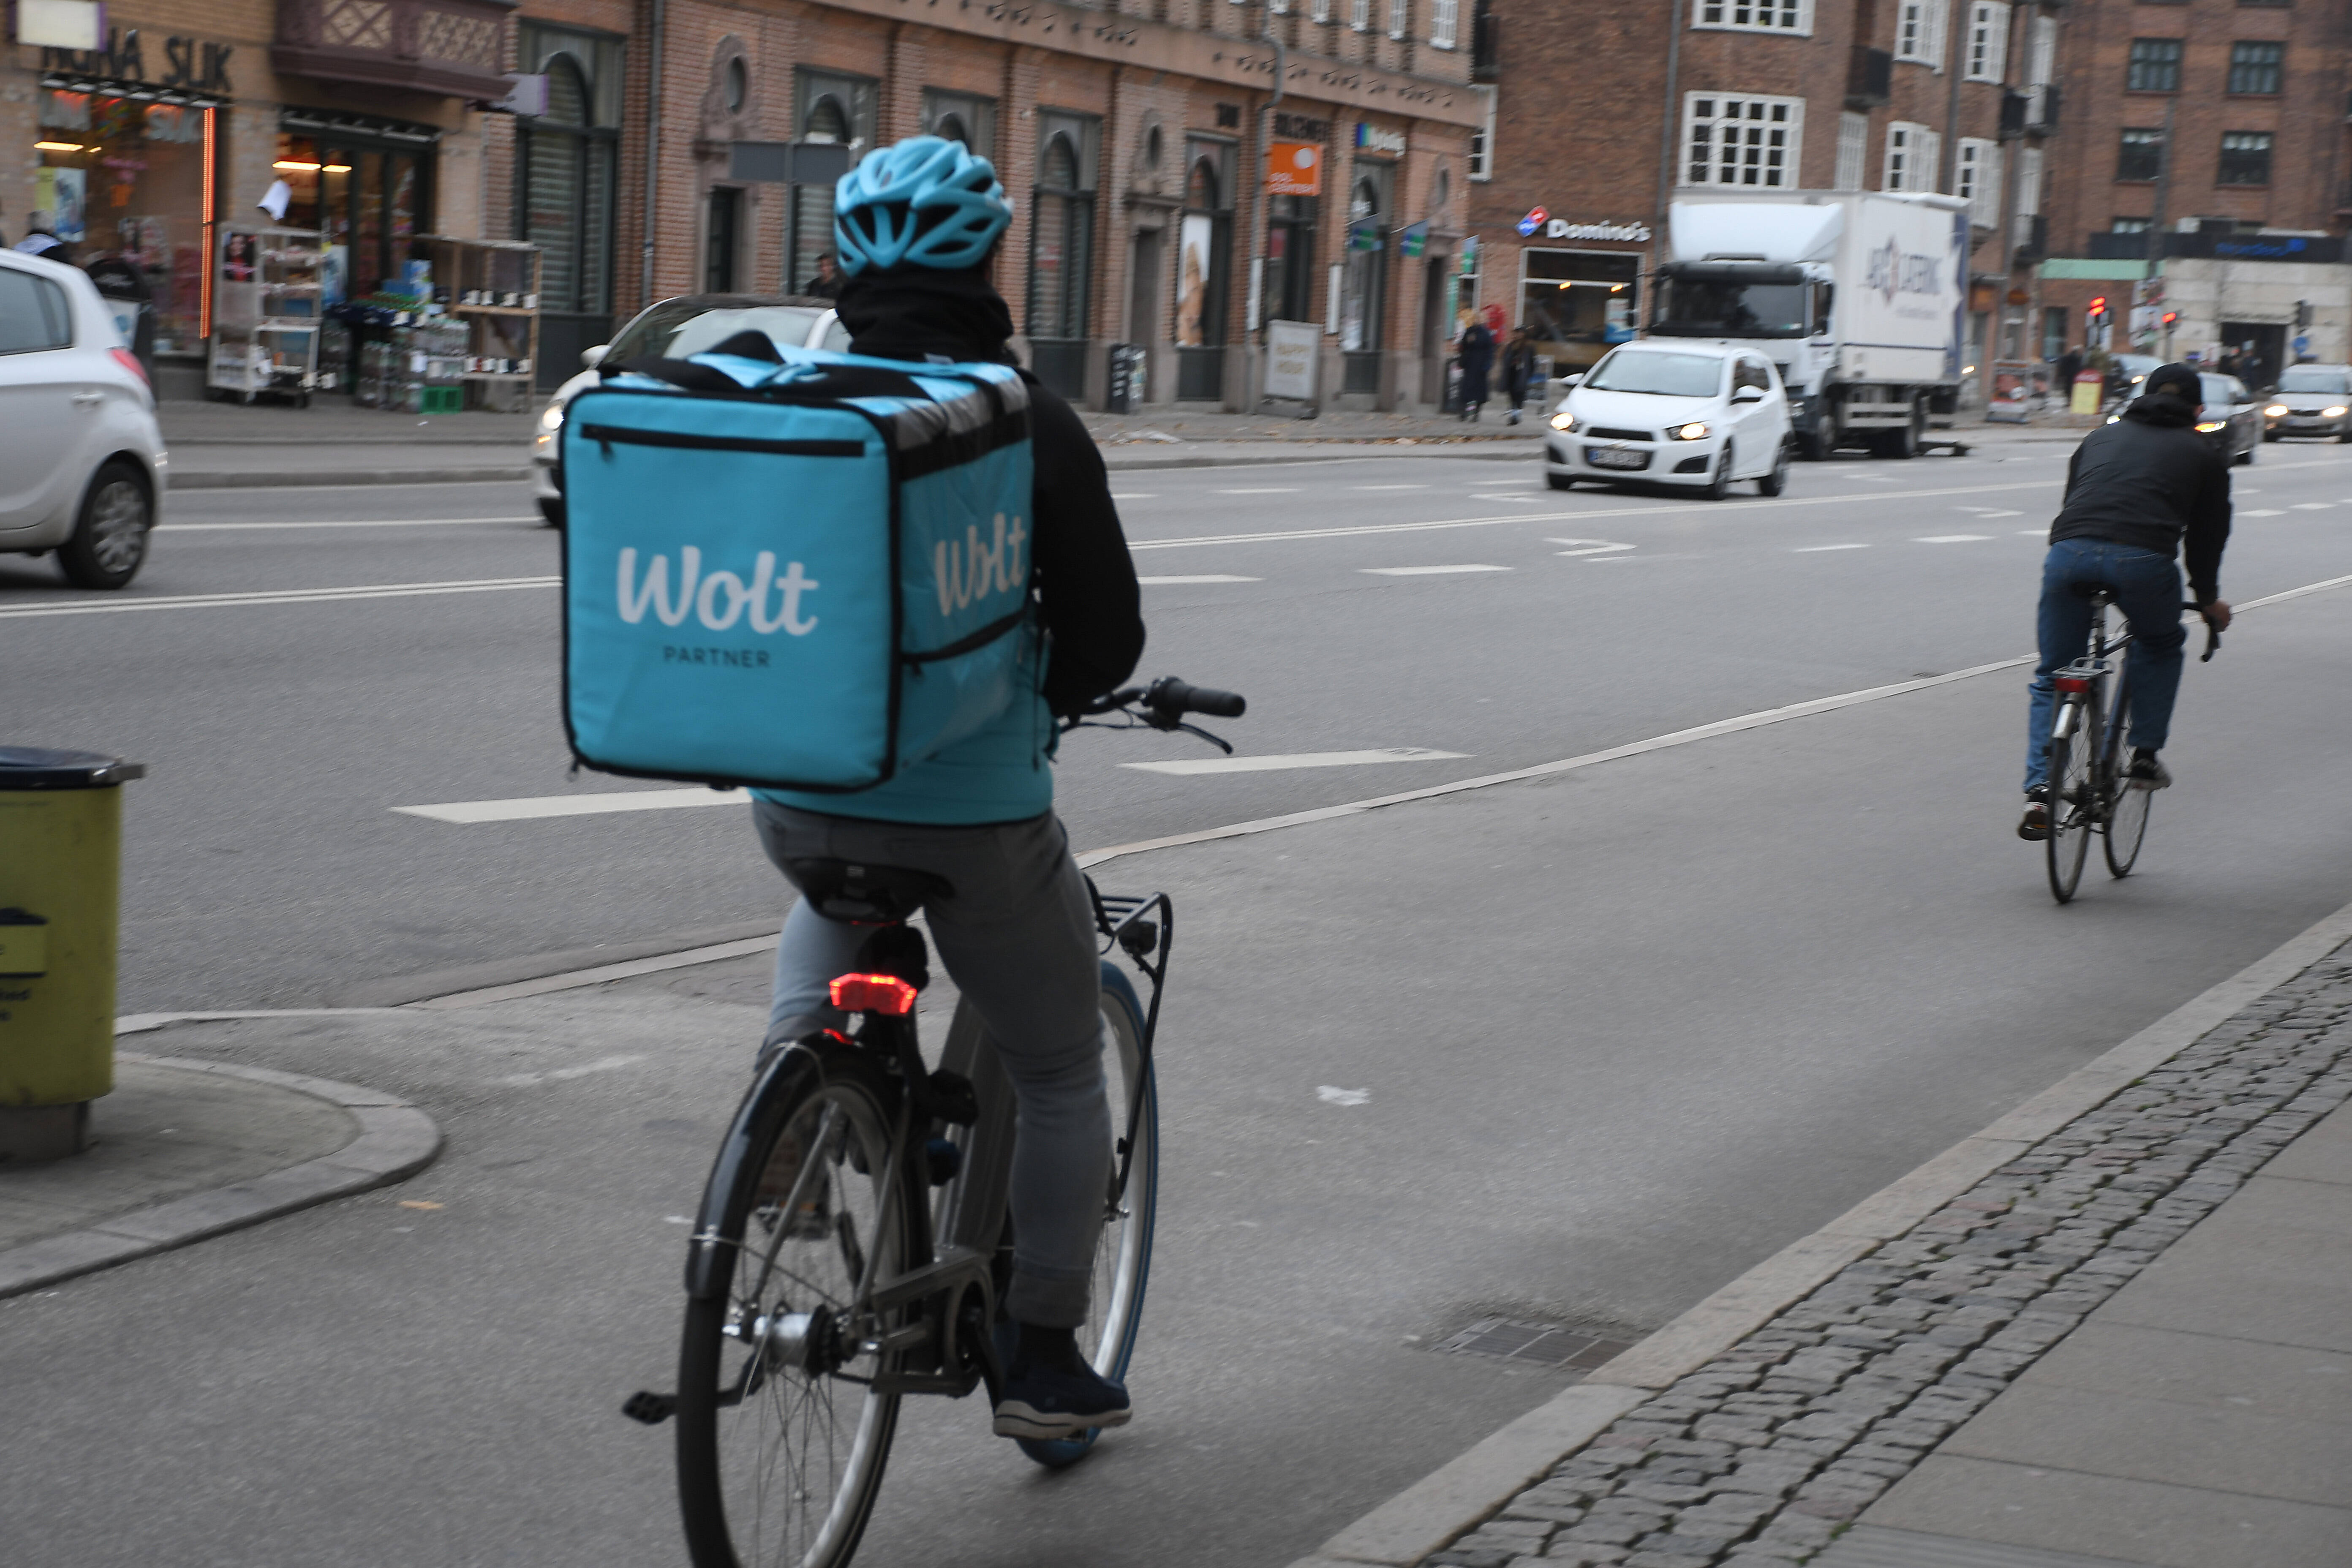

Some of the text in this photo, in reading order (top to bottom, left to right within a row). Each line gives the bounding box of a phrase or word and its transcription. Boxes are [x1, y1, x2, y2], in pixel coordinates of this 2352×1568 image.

[162, 36, 232, 93] SLIK
[1546, 218, 1652, 242] Domino's
[617, 545, 819, 635] Wolt
[934, 512, 1026, 617] Wolt
[662, 645, 771, 668] PARTNER
